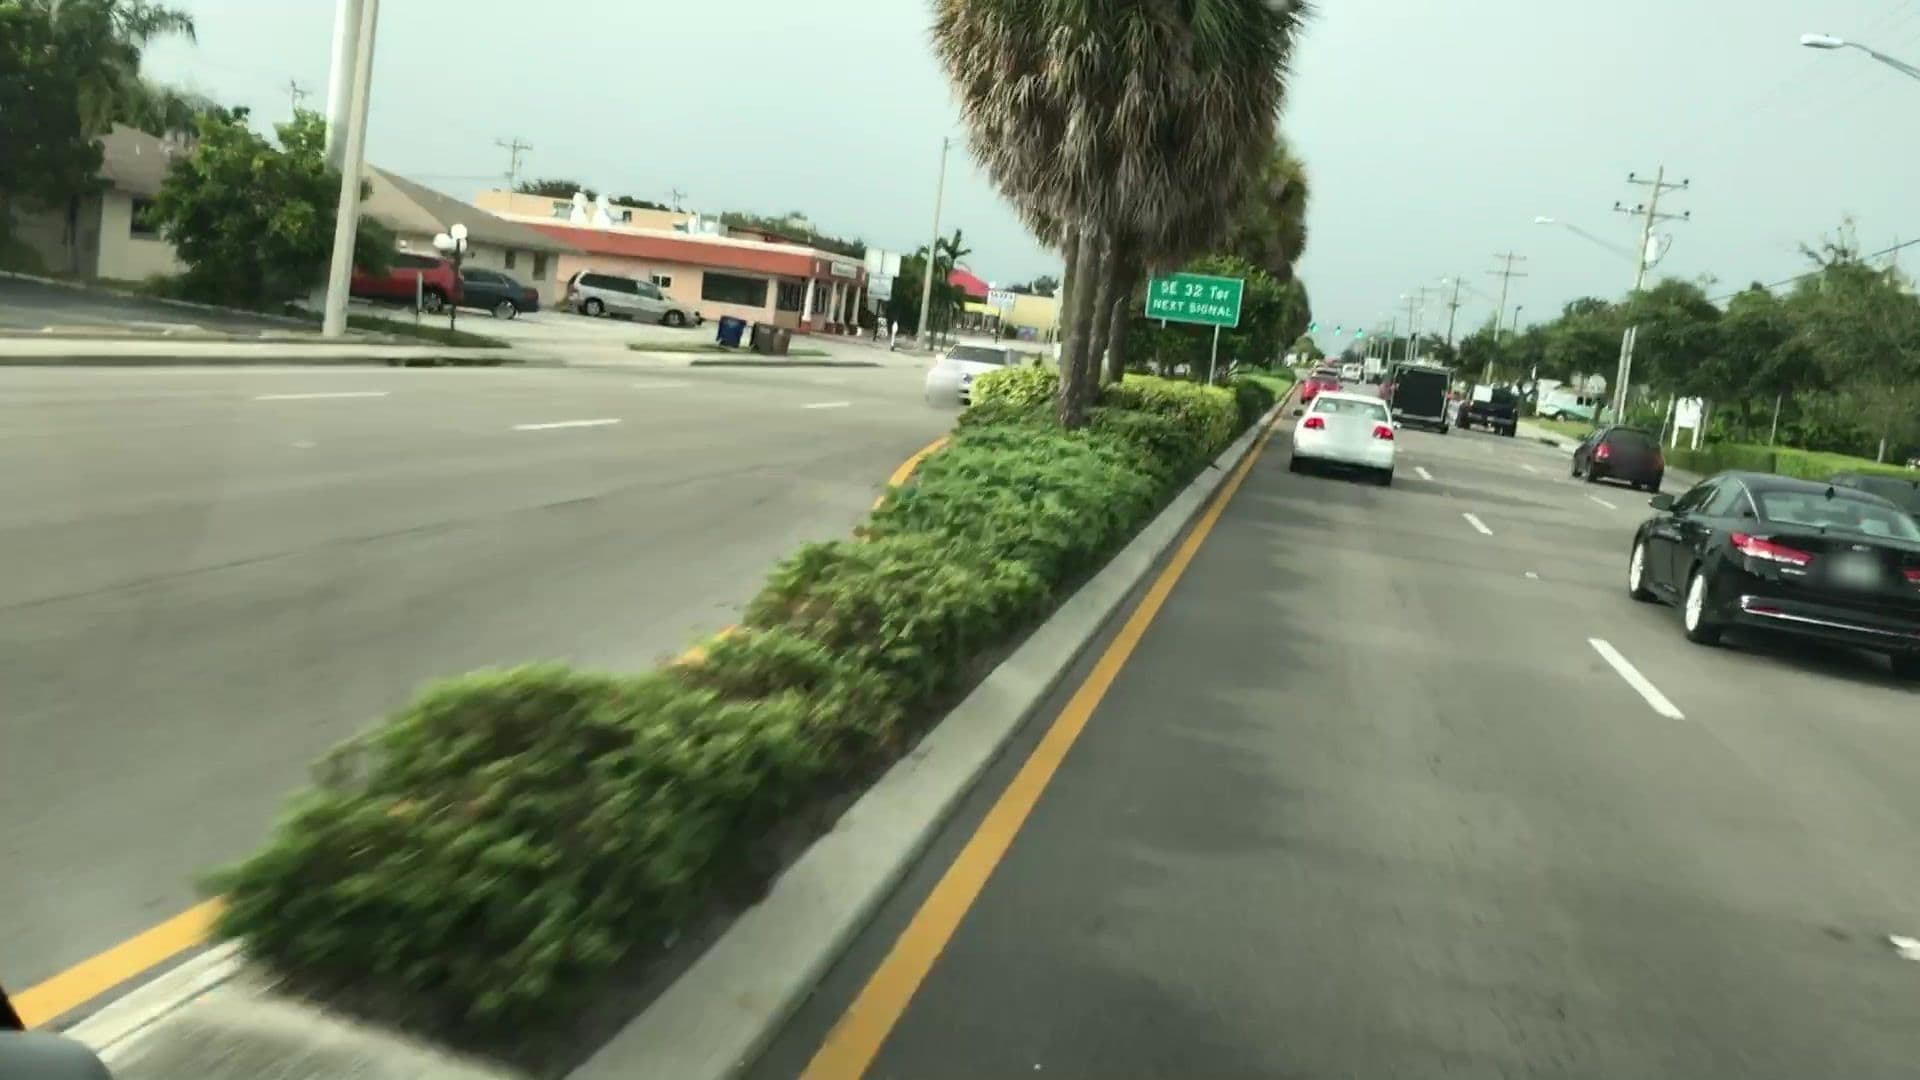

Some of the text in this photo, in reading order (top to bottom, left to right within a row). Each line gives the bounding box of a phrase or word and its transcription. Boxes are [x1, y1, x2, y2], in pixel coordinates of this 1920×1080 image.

[1161, 281, 1231, 300] SE 32 Ter
[1153, 300, 1232, 316] NEXT SIGNAL
